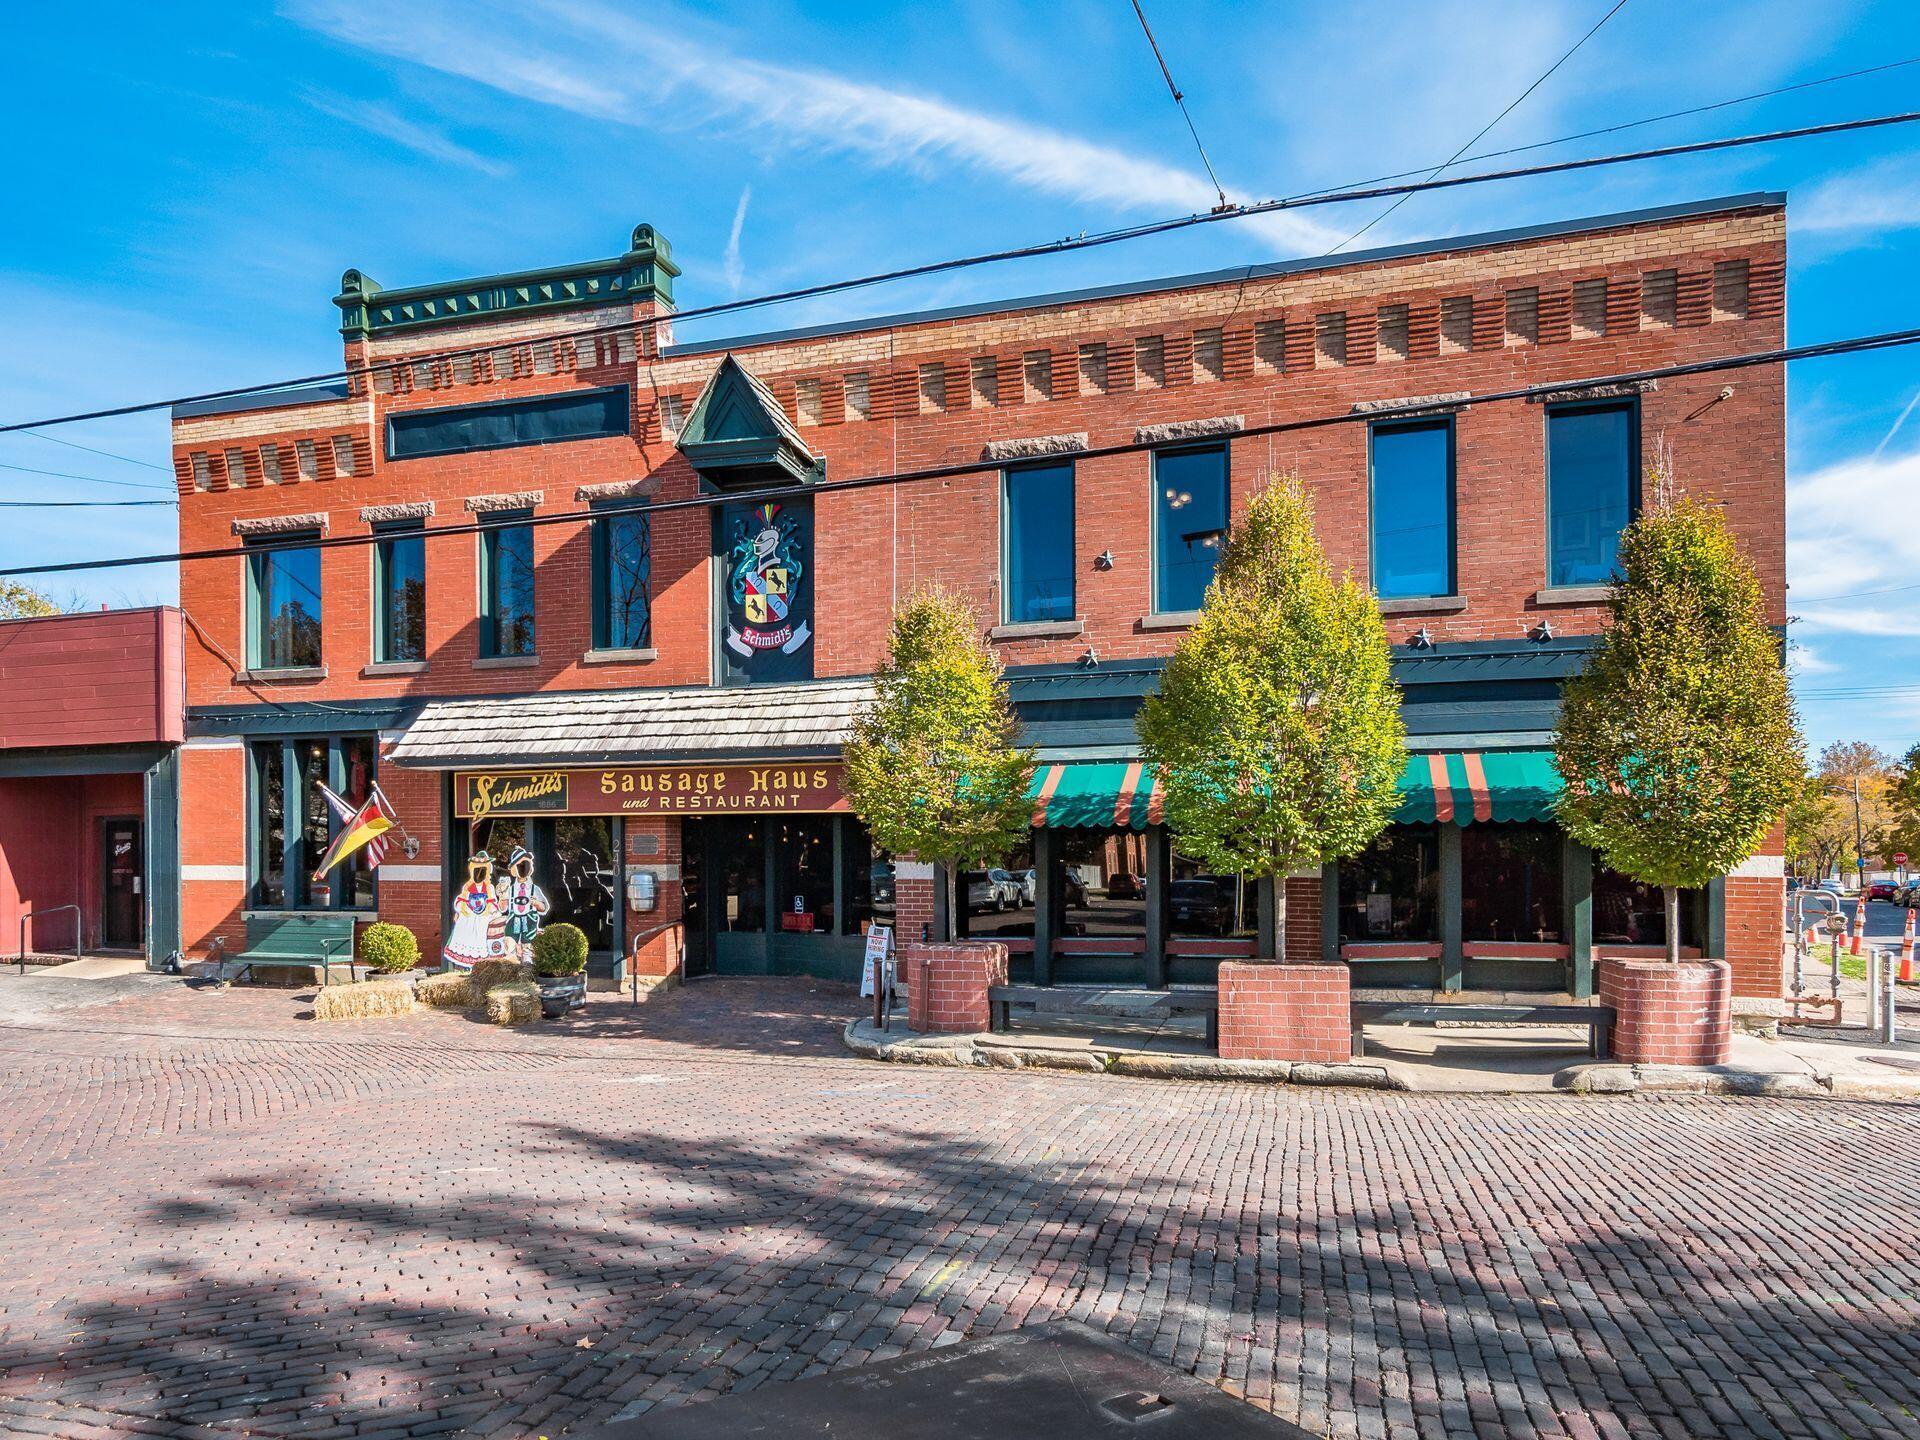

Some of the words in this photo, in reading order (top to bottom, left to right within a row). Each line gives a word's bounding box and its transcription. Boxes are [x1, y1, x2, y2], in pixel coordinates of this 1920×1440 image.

[742, 628, 792, 646] Schmidt's
[600, 771, 727, 794] Sausage
[748, 769, 828, 792] Haus
[472, 772, 562, 820] Schmidt's
[622, 796, 650, 809] und
[660, 794, 800, 808] RESTAURANT
